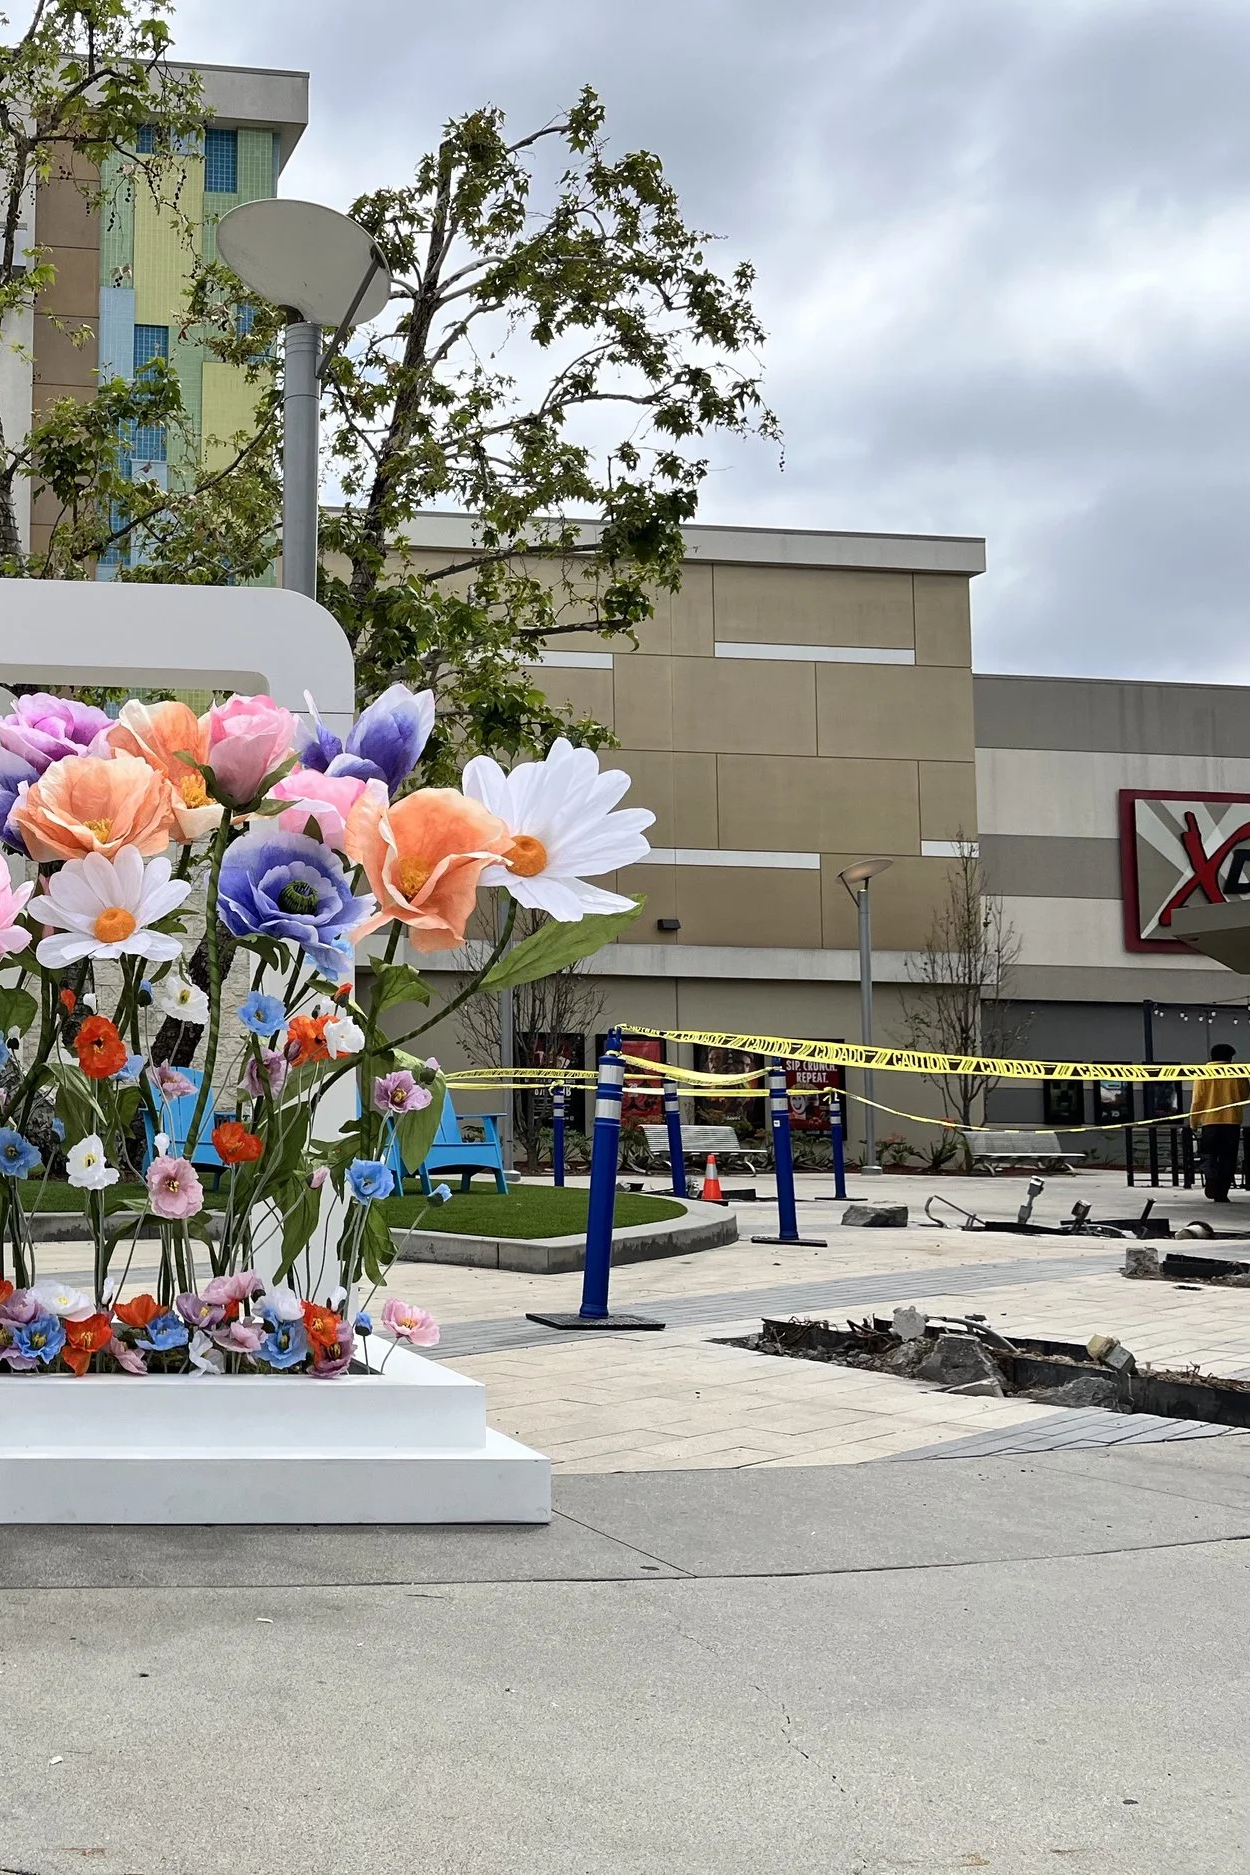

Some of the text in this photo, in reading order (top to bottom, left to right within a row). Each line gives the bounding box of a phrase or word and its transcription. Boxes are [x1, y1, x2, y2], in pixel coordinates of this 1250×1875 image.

[744, 1038, 793, 1057] CAUTION
[814, 1044, 866, 1063] CUIDADO
[892, 1051, 951, 1071] CAUTION
[980, 1060, 1045, 1076] CUIDADO
[1078, 1065, 1147, 1078] CAUTION
[1184, 1065, 1250, 1078] CUIDAD
[785, 1060, 838, 1072] SIP. CRUNCH.
[796, 1071, 829, 1083] REPEAT.
